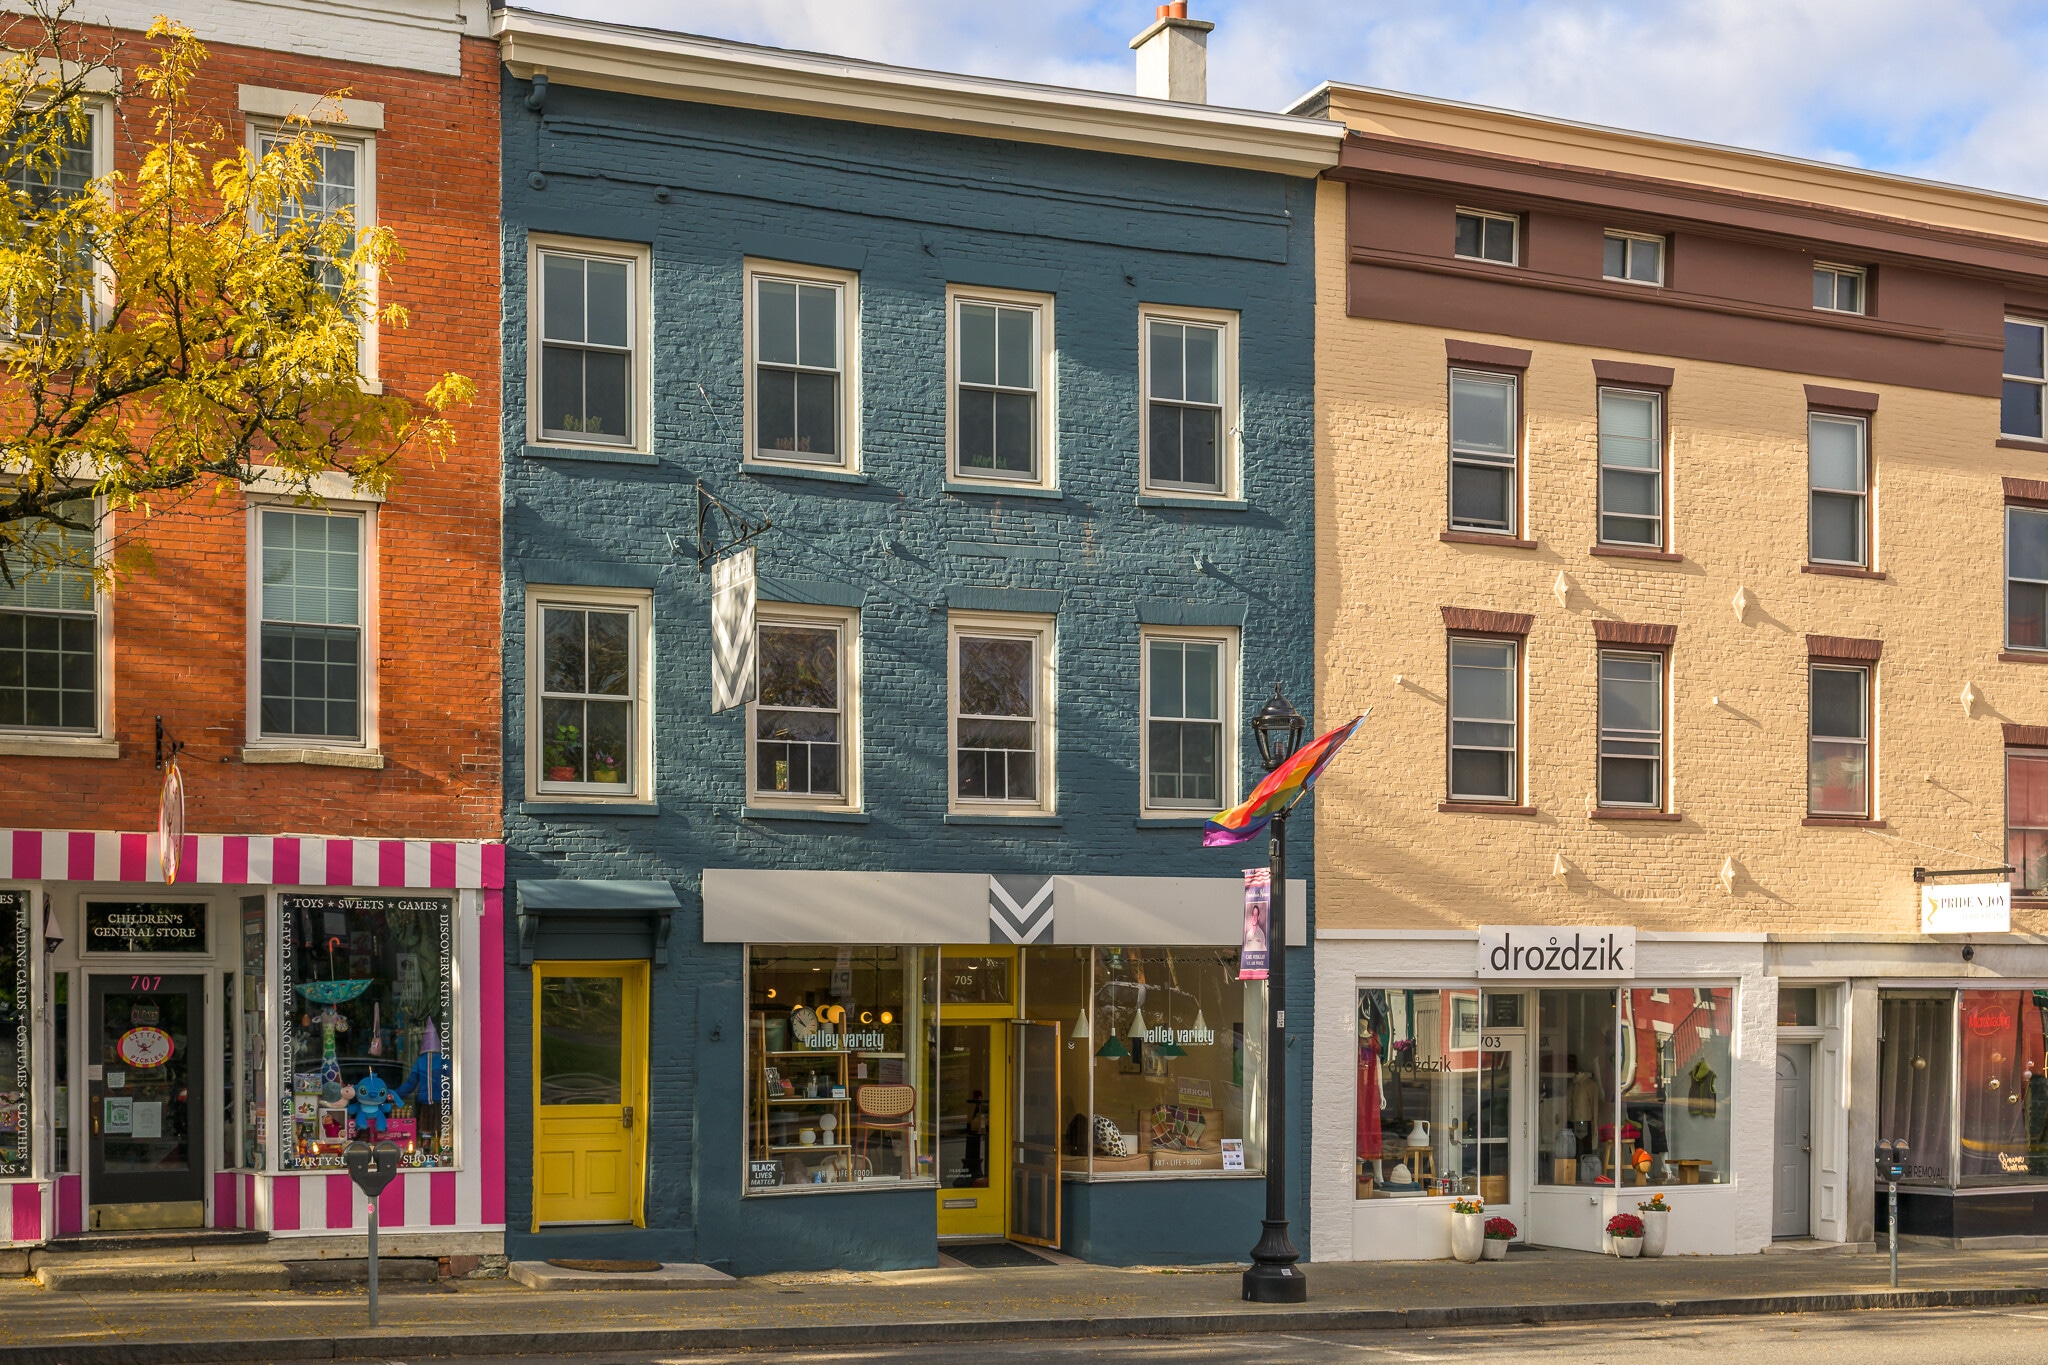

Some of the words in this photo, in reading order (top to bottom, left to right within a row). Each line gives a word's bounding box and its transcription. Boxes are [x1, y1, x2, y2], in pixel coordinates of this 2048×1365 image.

[293, 898, 324, 908] TOYS
[338, 900, 384, 909] SWEETS
[398, 901, 438, 910] GAMES
[1941, 897, 1974, 908] PRIDE
[1986, 896, 2006, 907] JOY
[108, 914, 183, 924] CHILDREN'S
[16, 909, 26, 967] TRADING
[94, 927, 154, 937] GENERAL
[156, 928, 196, 938] STORE
[281, 912, 291, 959] CRAFTS
[440, 914, 449, 980] DISCOVERY
[131, 975, 161, 991] 707
[955, 975, 973, 985] 705
[16, 971, 27, 1010] CARDS
[282, 976, 291, 1006] ARTS
[440, 982, 450, 1007] KITS
[128, 1032, 163, 1041] LITTLE
[440, 1022, 450, 1060] DOLLS
[804, 1030, 838, 1050] valley
[842, 1029, 884, 1050] variety
[1143, 1026, 1174, 1045] valley
[1177, 1026, 1214, 1045] variety
[17, 1025, 27, 1087] COSTUMES
[130, 1052, 164, 1063] PICKLES
[282, 1020, 292, 1083] BALLOONS
[441, 1075, 450, 1150] ACCESSORIES
[18, 1103, 28, 1159] CLOTHES
[282, 1098, 292, 1154] MARBLES
[294, 1157, 333, 1167] PARTY
[402, 1154, 439, 1164] SHOES
[1154, 1159, 1165, 1167] ART
[1170, 1158, 1182, 1166] LIFE
[1186, 1158, 1202, 1166] FOOD
[751, 1163, 776, 1172] BLACK
[755, 1171, 773, 1179] LIVES
[817, 1170, 829, 1178] ART
[835, 1170, 848, 1178] LIFE
[853, 1169, 871, 1177] FOOD
[1914, 1165, 1945, 1179] REMOVAL
